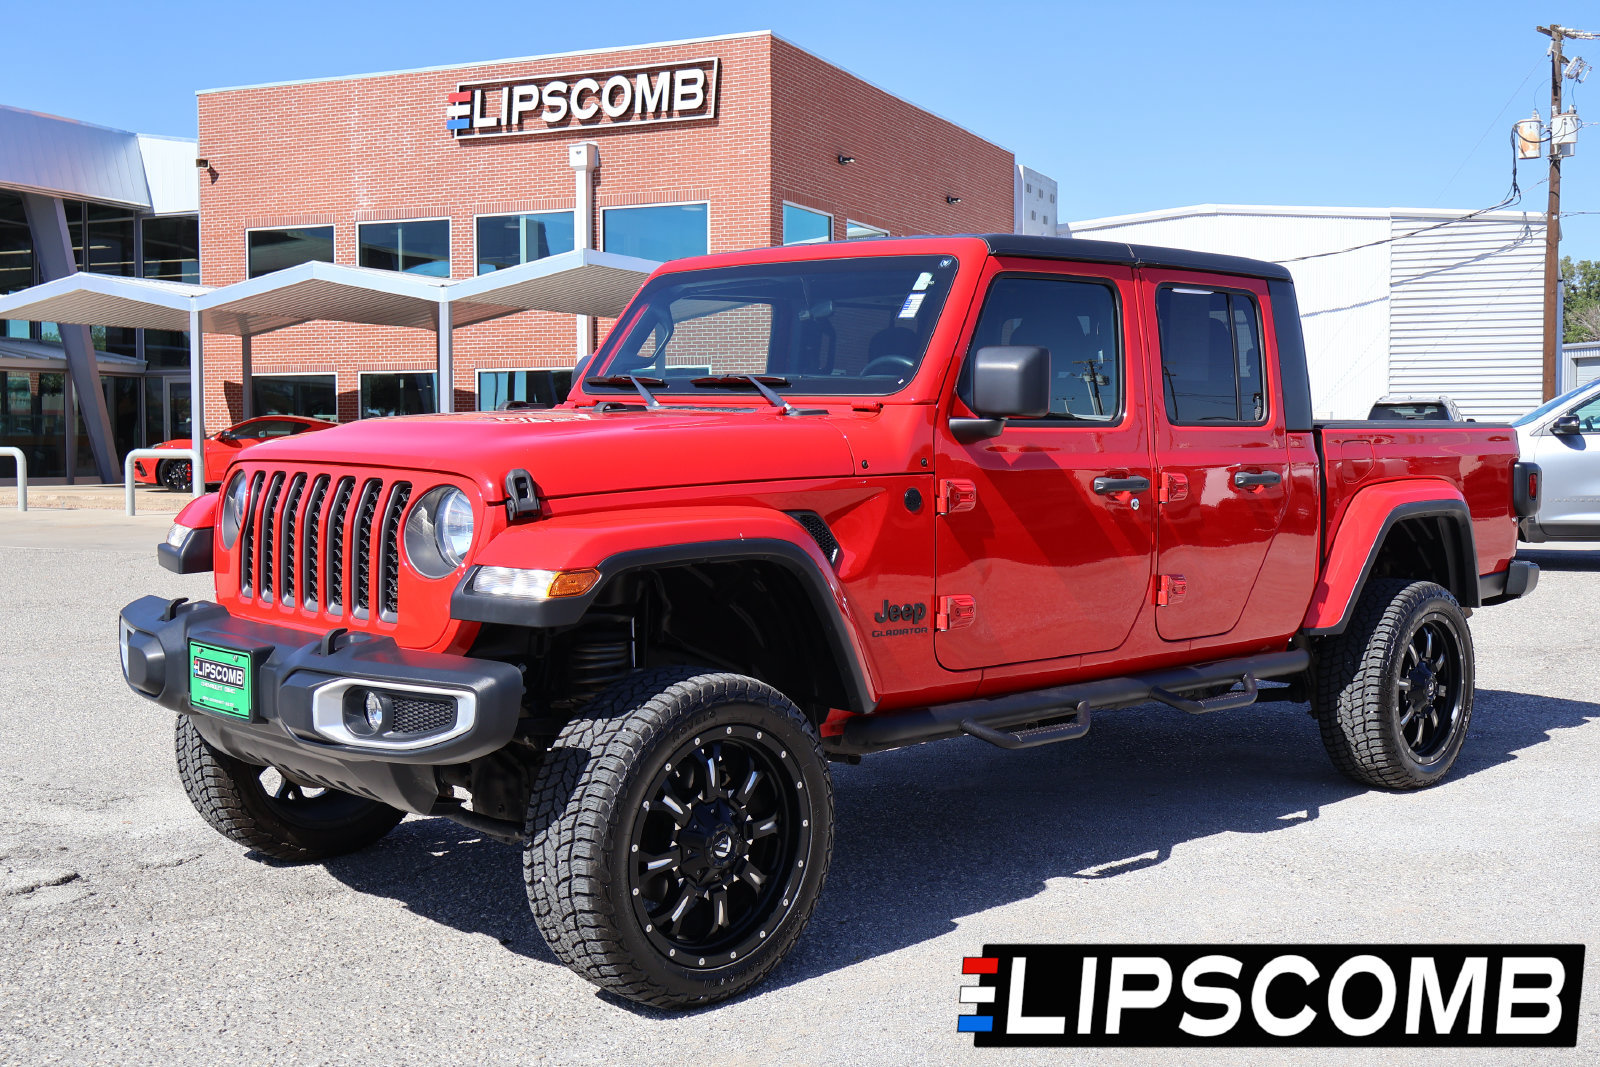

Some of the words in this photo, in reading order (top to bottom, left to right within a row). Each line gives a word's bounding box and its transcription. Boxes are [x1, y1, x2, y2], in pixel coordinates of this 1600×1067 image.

[473, 68, 705, 128] LIPSCOMB
[874, 599, 927, 624] Jeep
[872, 627, 928, 637] GLADIATOR
[198, 661, 243, 685] LIPSCOMB
